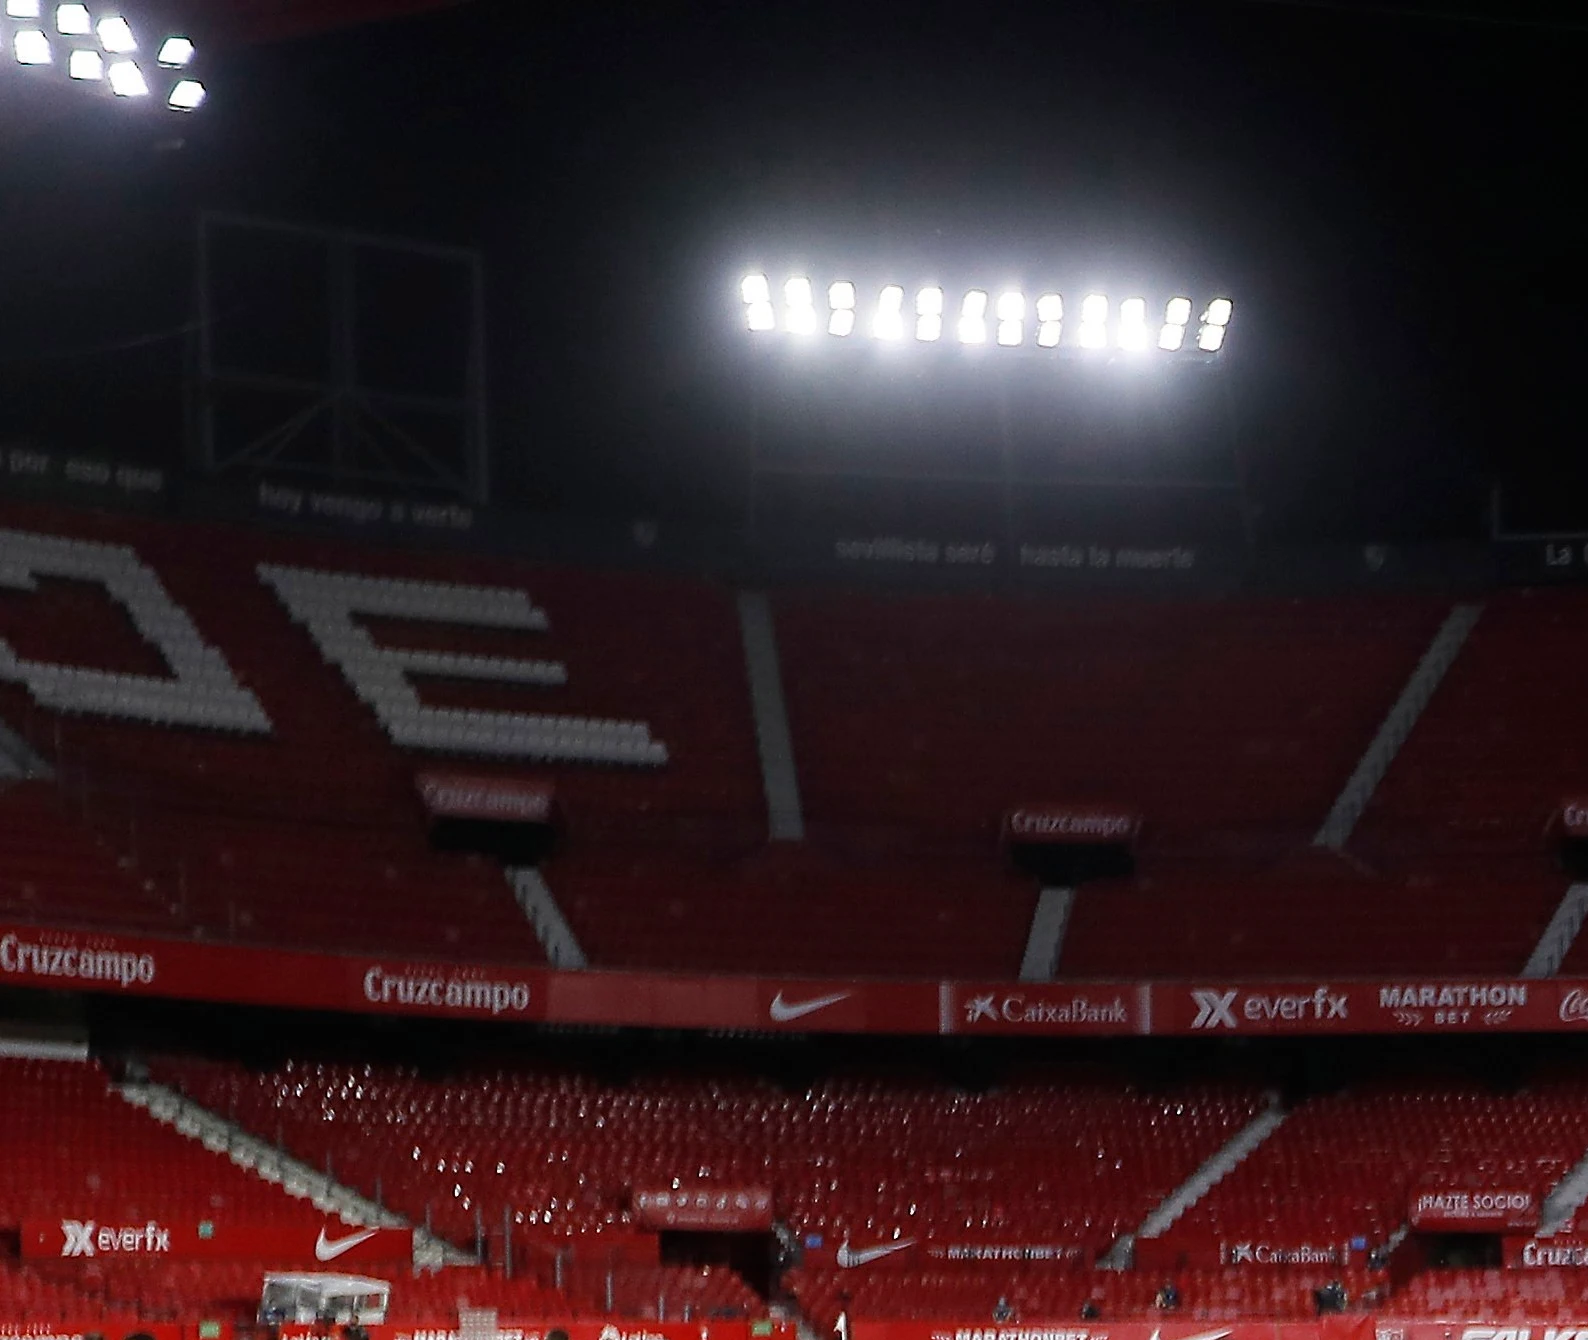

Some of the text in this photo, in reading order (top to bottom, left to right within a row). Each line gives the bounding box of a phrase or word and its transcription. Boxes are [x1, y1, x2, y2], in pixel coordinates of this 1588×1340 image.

[1546, 541, 1573, 567] La
[0, 932, 156, 988] Cruzcampo
[363, 965, 531, 1015] Cruzcampo
[1243, 986, 1348, 1020] everfx
[1379, 984, 1528, 1009] MARATHON
[1001, 999, 1129, 1025] CaixaBank
[1434, 1011, 1471, 1025] BET
[98, 1220, 171, 1252] everfx
